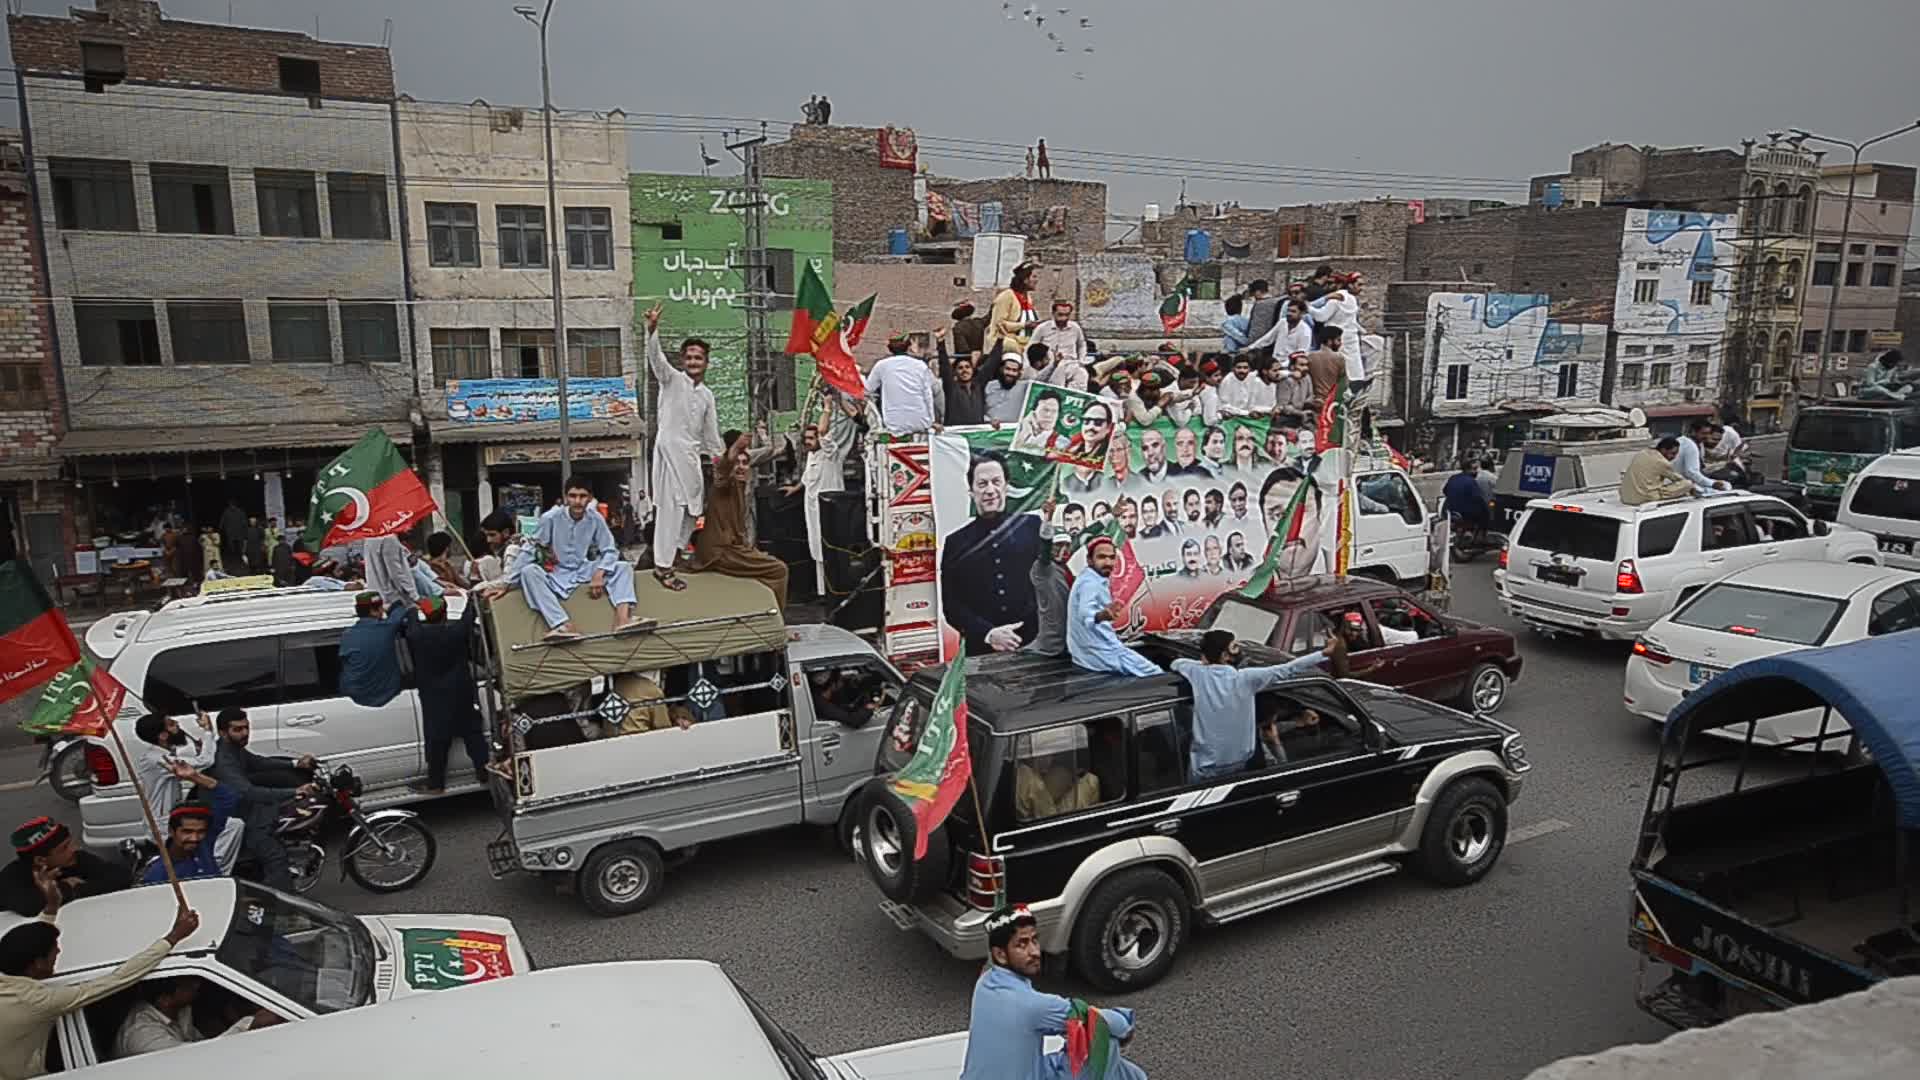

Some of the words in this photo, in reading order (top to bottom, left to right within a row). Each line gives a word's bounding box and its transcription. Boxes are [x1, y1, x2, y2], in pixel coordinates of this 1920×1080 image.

[663, 249, 704, 276] جہاں
[705, 241, 738, 280] آپ
[1064, 395, 1086, 409] PTI
[413, 952, 438, 984] PTI
